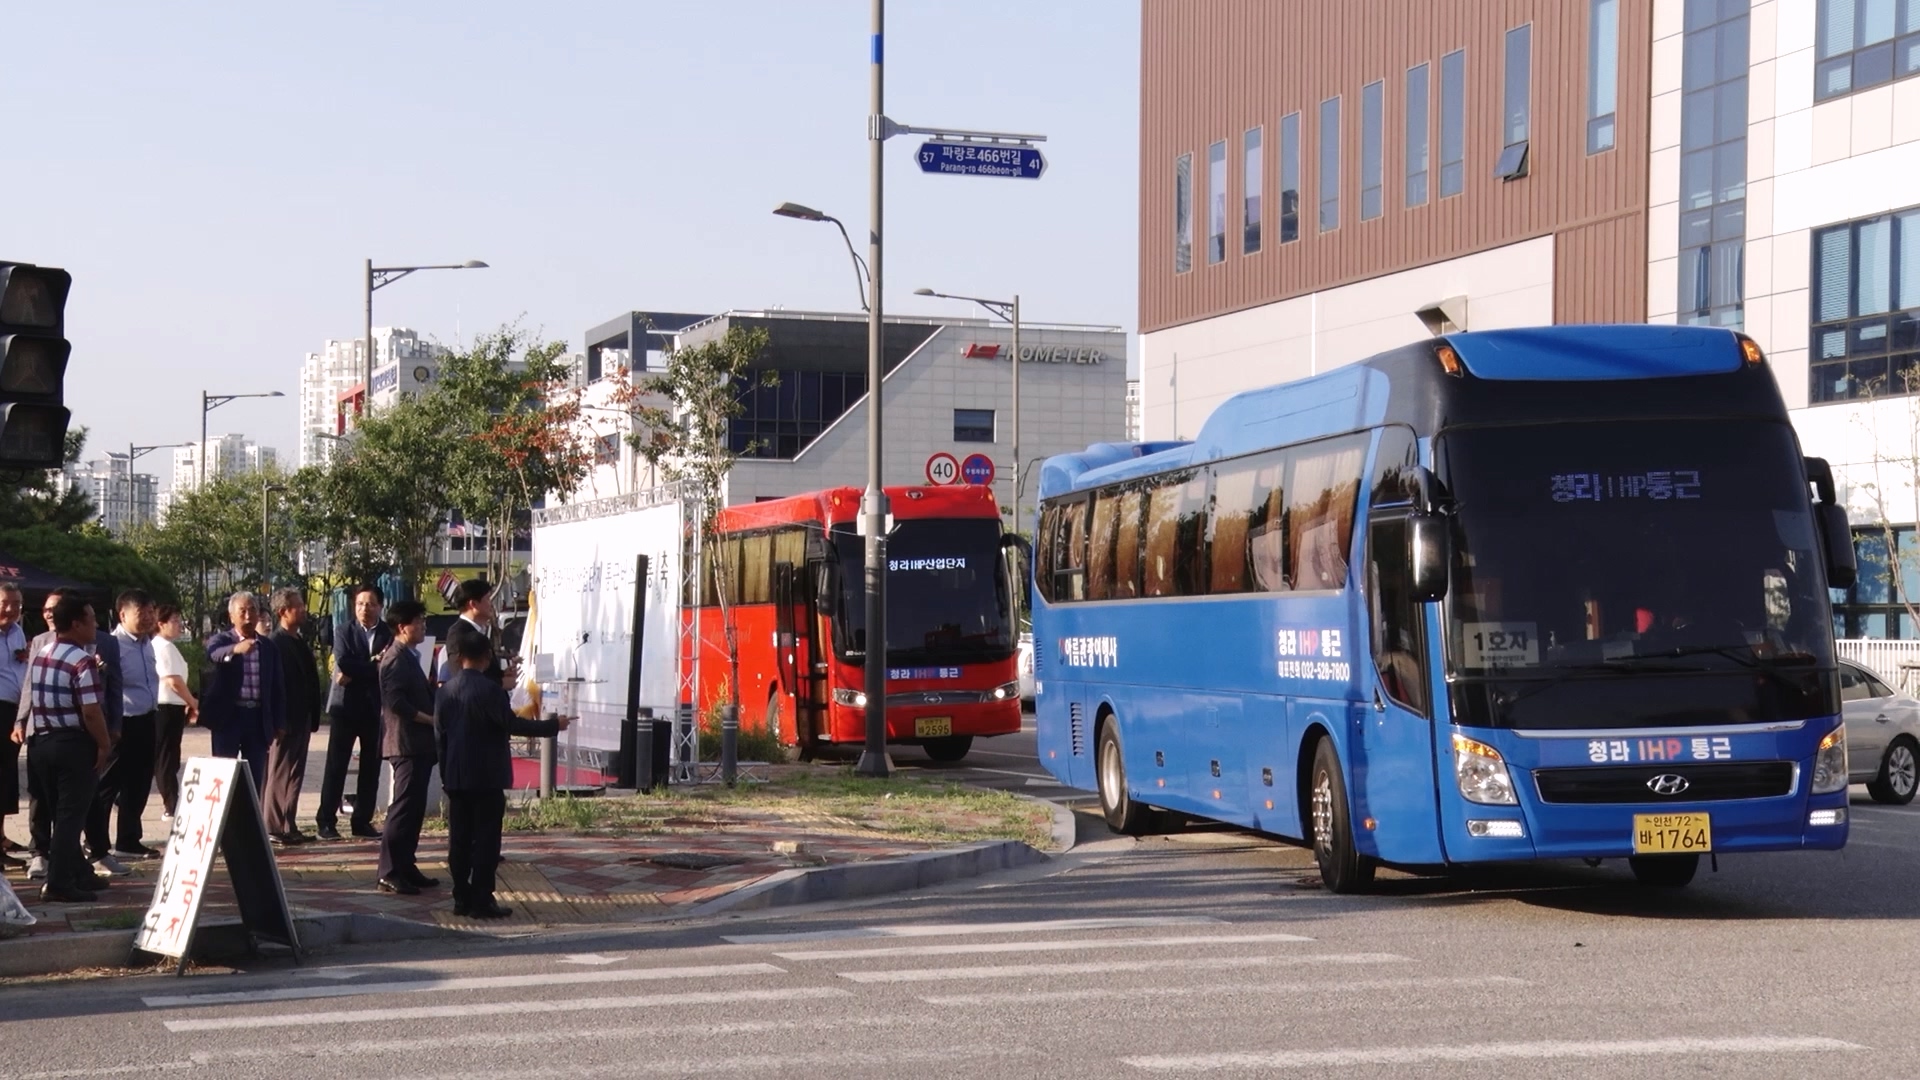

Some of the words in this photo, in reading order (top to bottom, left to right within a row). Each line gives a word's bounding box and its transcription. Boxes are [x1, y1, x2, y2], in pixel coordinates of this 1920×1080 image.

[922, 152, 934, 163] 37
[942, 146, 1021, 165] 파랑로466번길
[941, 162, 976, 174] Parang-ro
[978, 164, 1022, 177] 466beon-gil
[1029, 159, 1040, 169] 41
[933, 462, 953, 478] 40
[1299, 629, 1319, 656] IHP
[1322, 629, 1341, 657] 통근
[890, 669, 910, 679] 청라
[1588, 740, 1630, 762] 청라
[1639, 738, 1682, 761] IHP
[1691, 737, 1732, 760] 통근
[164, 777, 224, 948] 주차금지
